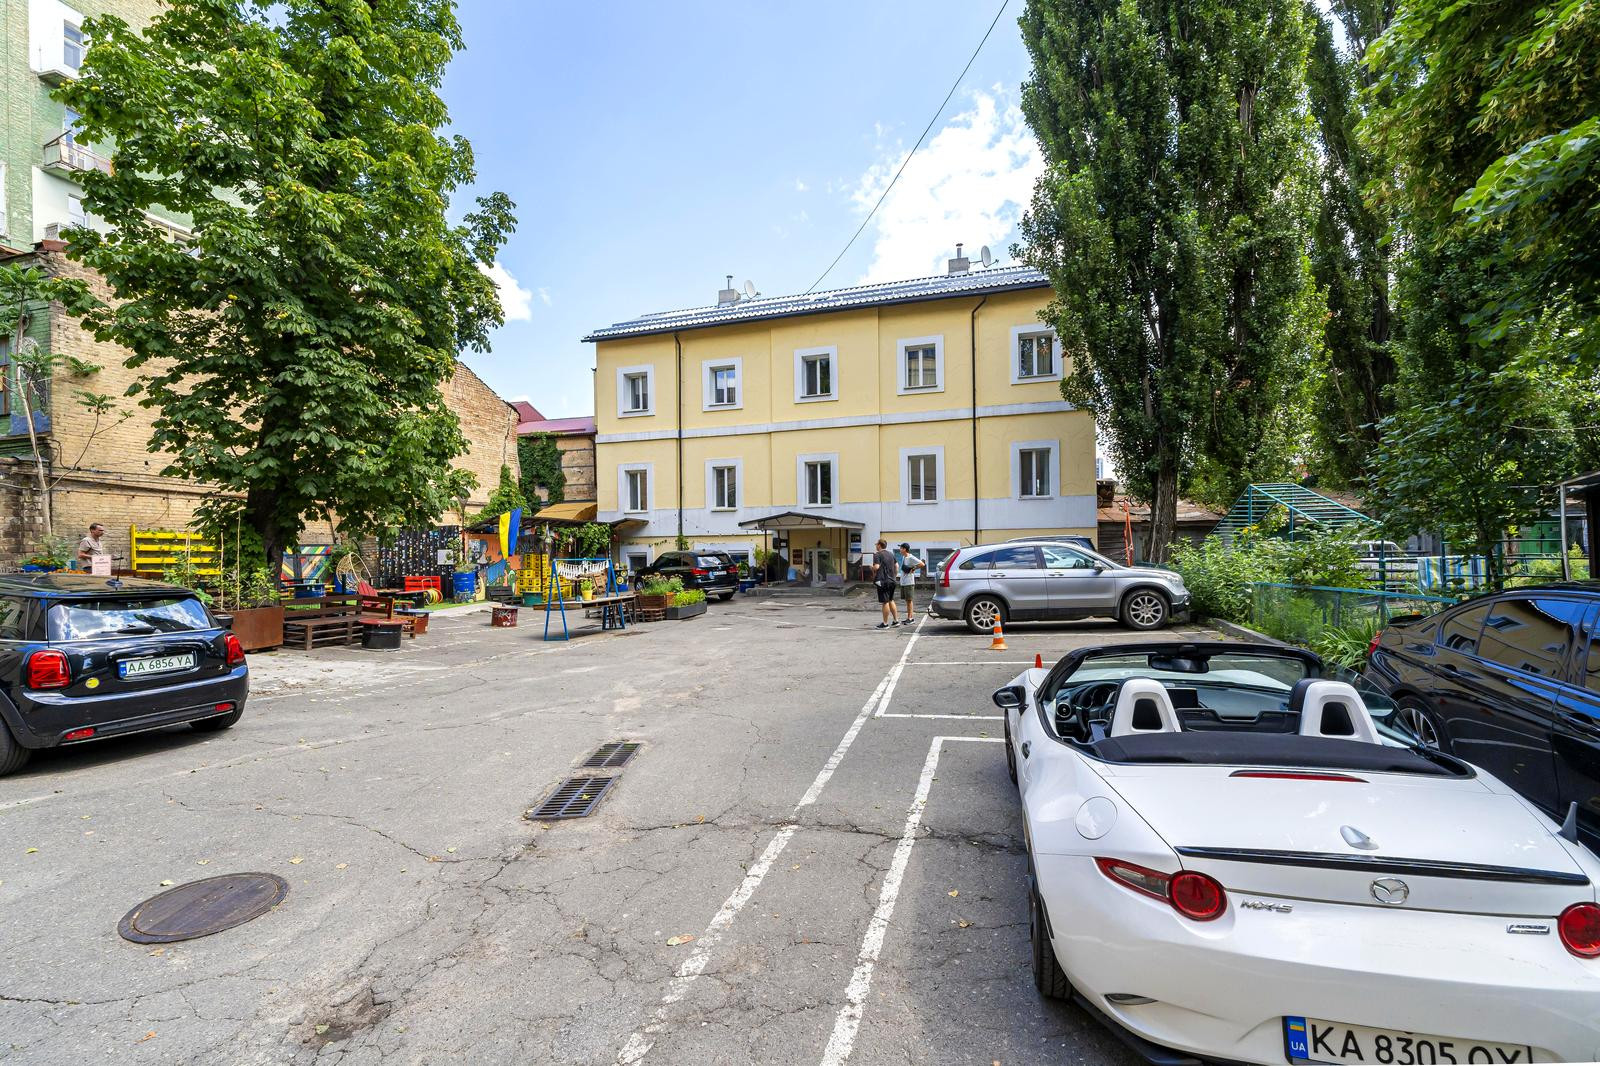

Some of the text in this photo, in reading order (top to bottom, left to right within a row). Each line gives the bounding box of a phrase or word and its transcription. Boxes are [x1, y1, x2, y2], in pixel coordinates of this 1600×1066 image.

[128, 661, 146, 673] AA
[148, 658, 174, 670] 6856
[176, 655, 192, 666] YA
[1291, 1040, 1307, 1053] UA
[1311, 1024, 1364, 1062] KA
[1374, 1034, 1457, 1065] 8305
